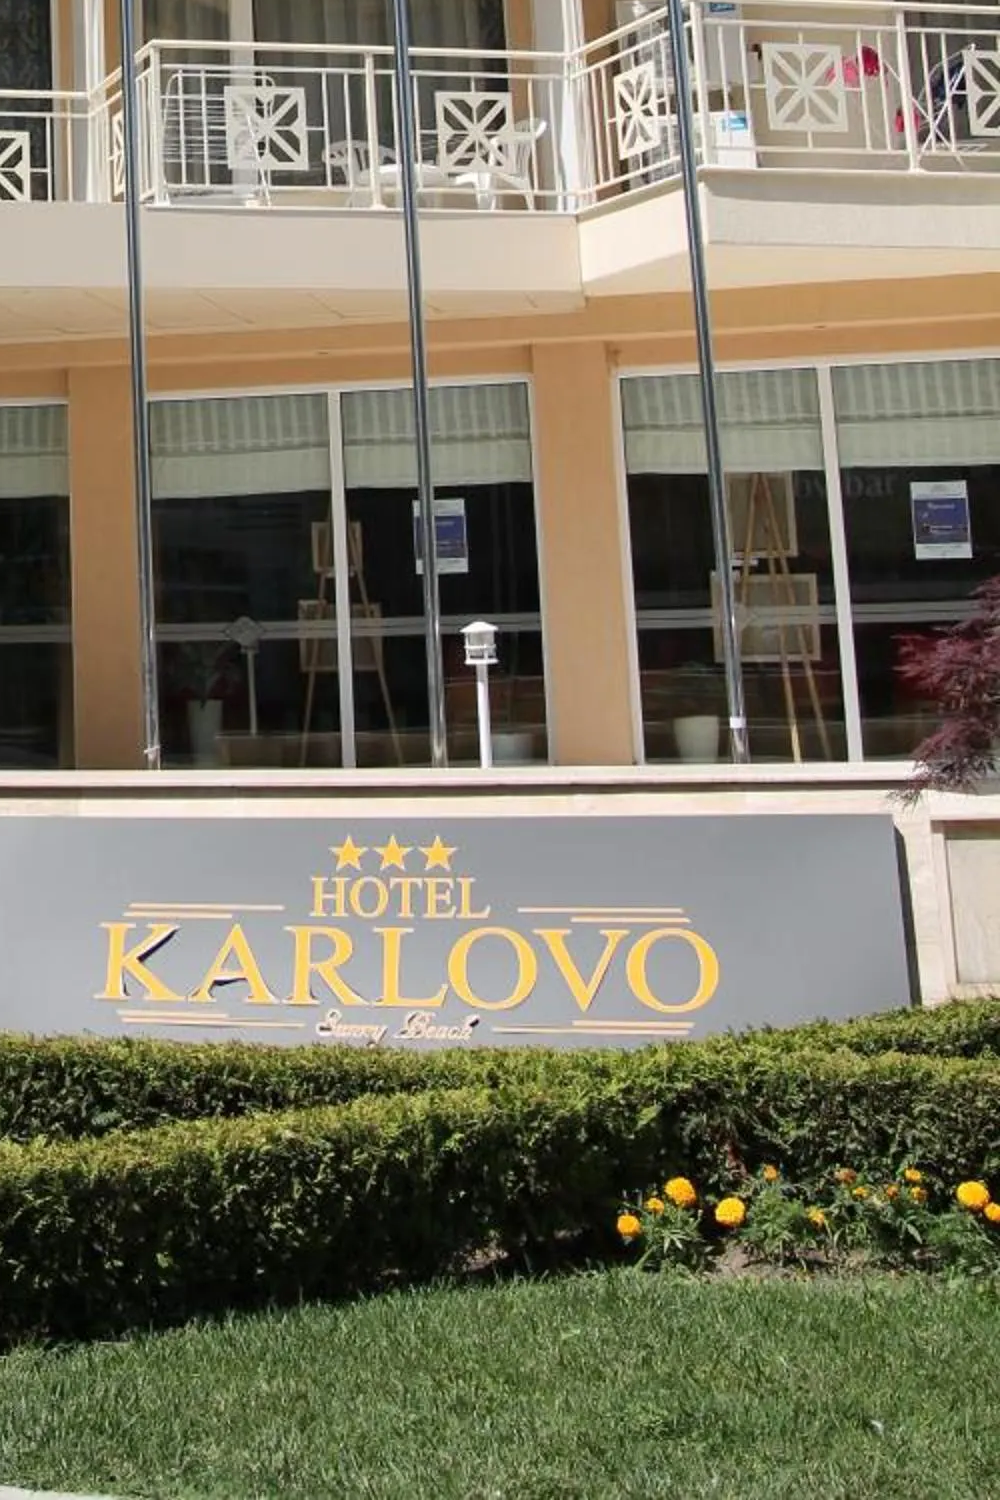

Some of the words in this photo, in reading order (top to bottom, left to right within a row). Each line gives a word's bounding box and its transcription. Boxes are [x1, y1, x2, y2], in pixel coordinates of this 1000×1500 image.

[309, 876, 491, 919] HOTEL
[94, 921, 719, 1014] KARLOVO
[316, 1008, 388, 1048] Sunny
[394, 1009, 481, 1040] Beach
